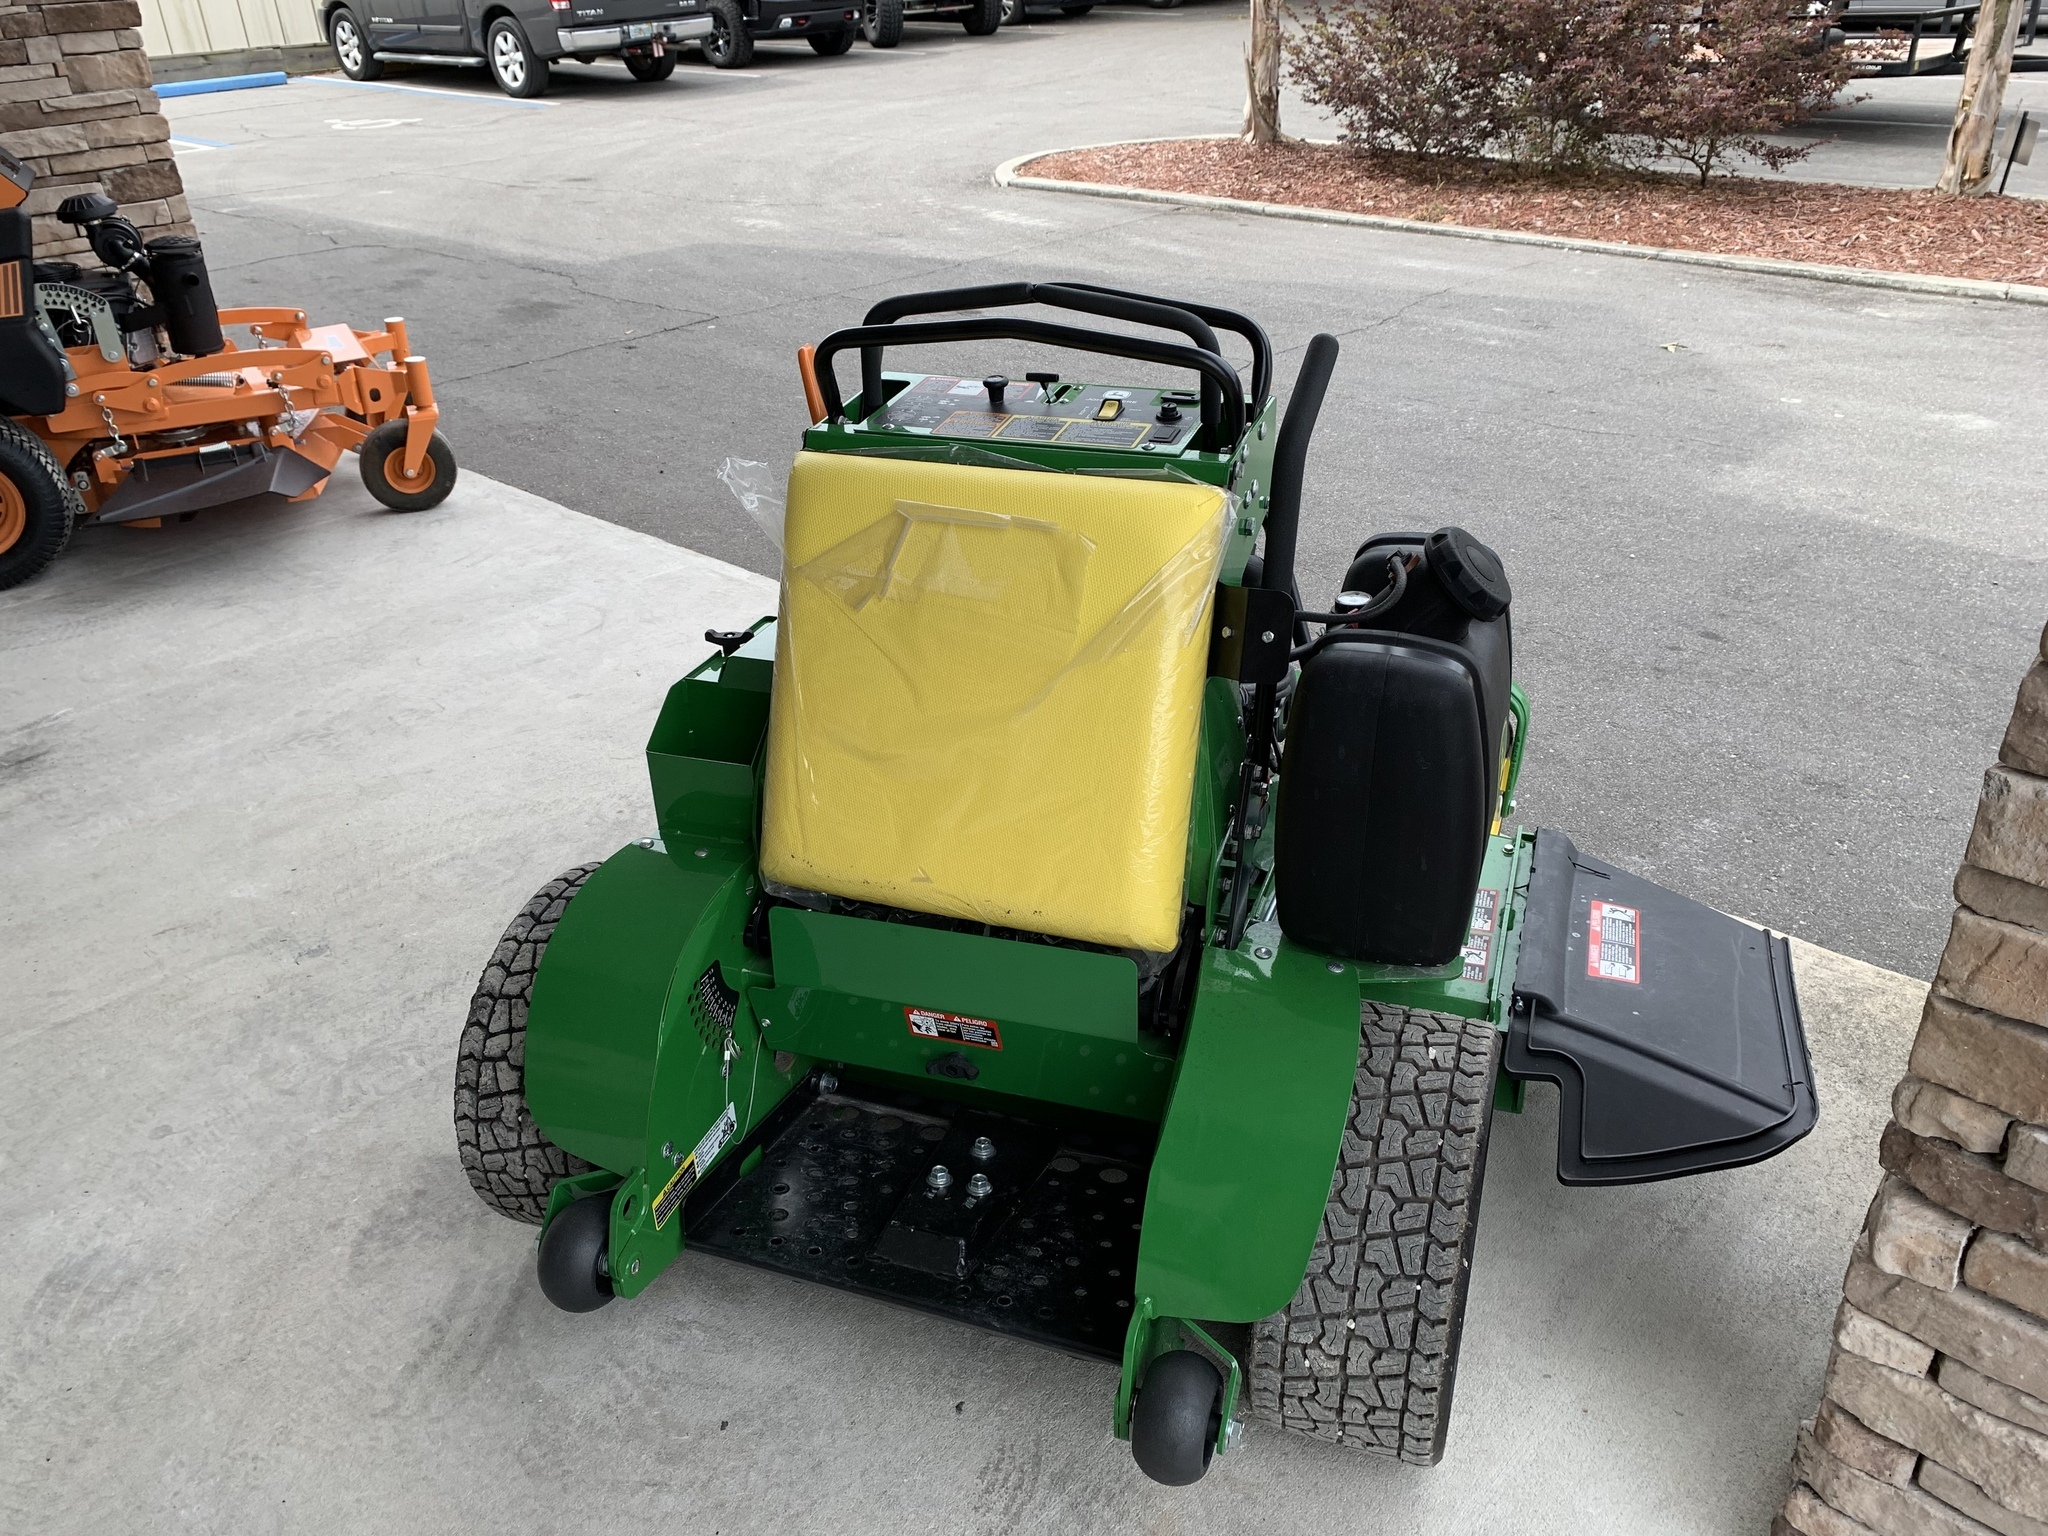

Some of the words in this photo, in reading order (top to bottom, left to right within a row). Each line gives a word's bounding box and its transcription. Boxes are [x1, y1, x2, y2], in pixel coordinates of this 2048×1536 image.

[576, 8, 604, 17] TITAN
[920, 1010, 945, 1020] DANGER
[961, 1017, 988, 1027] PELIGRO
[666, 1164, 686, 1190] CAUTION
